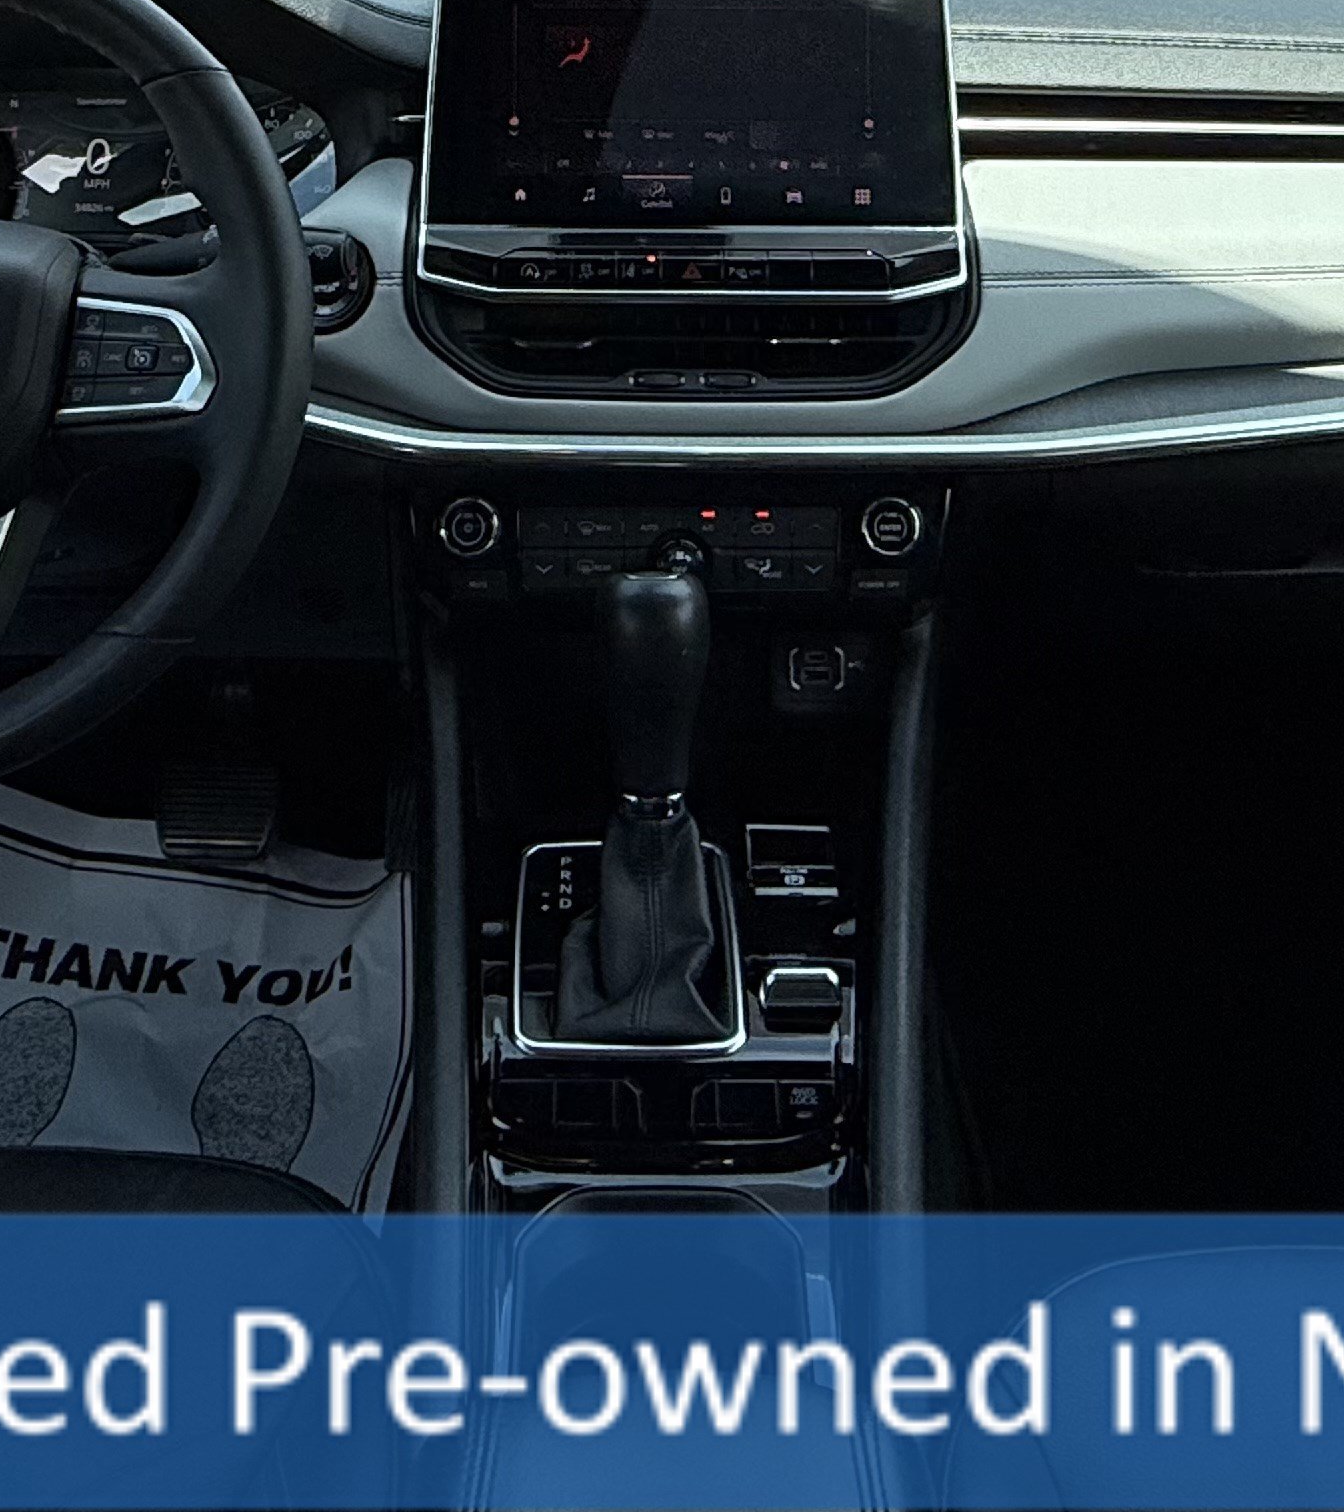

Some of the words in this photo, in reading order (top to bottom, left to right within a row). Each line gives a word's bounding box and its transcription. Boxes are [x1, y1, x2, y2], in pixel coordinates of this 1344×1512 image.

[86, 138, 111, 176] 0
[82, 178, 112, 190] MPH
[559, 897, 573, 910] D
[216, 944, 354, 1005] YOU!
